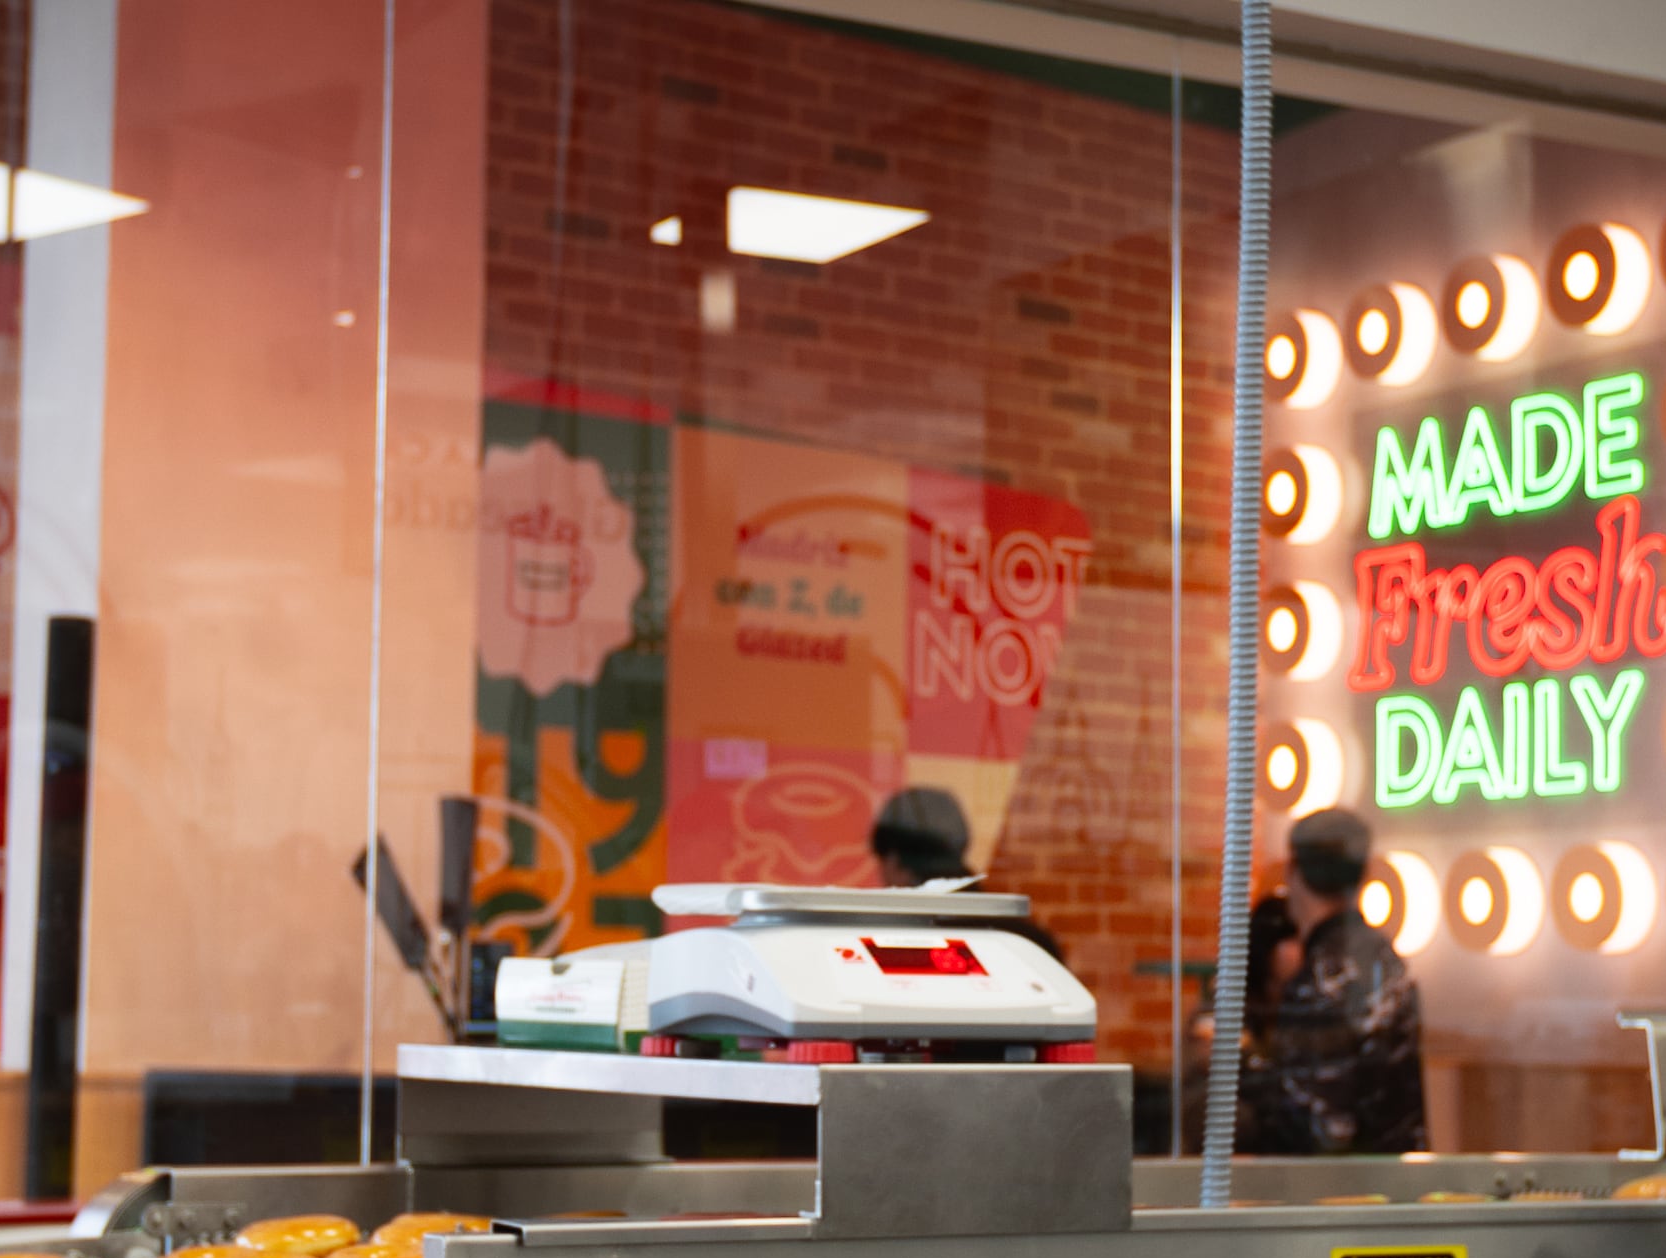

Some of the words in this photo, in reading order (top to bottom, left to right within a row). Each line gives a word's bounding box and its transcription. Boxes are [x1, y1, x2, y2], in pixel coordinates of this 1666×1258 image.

[1367, 372, 1645, 540] MADE
[932, 523, 1094, 620] HOT
[1374, 668, 1646, 809] DAILY
